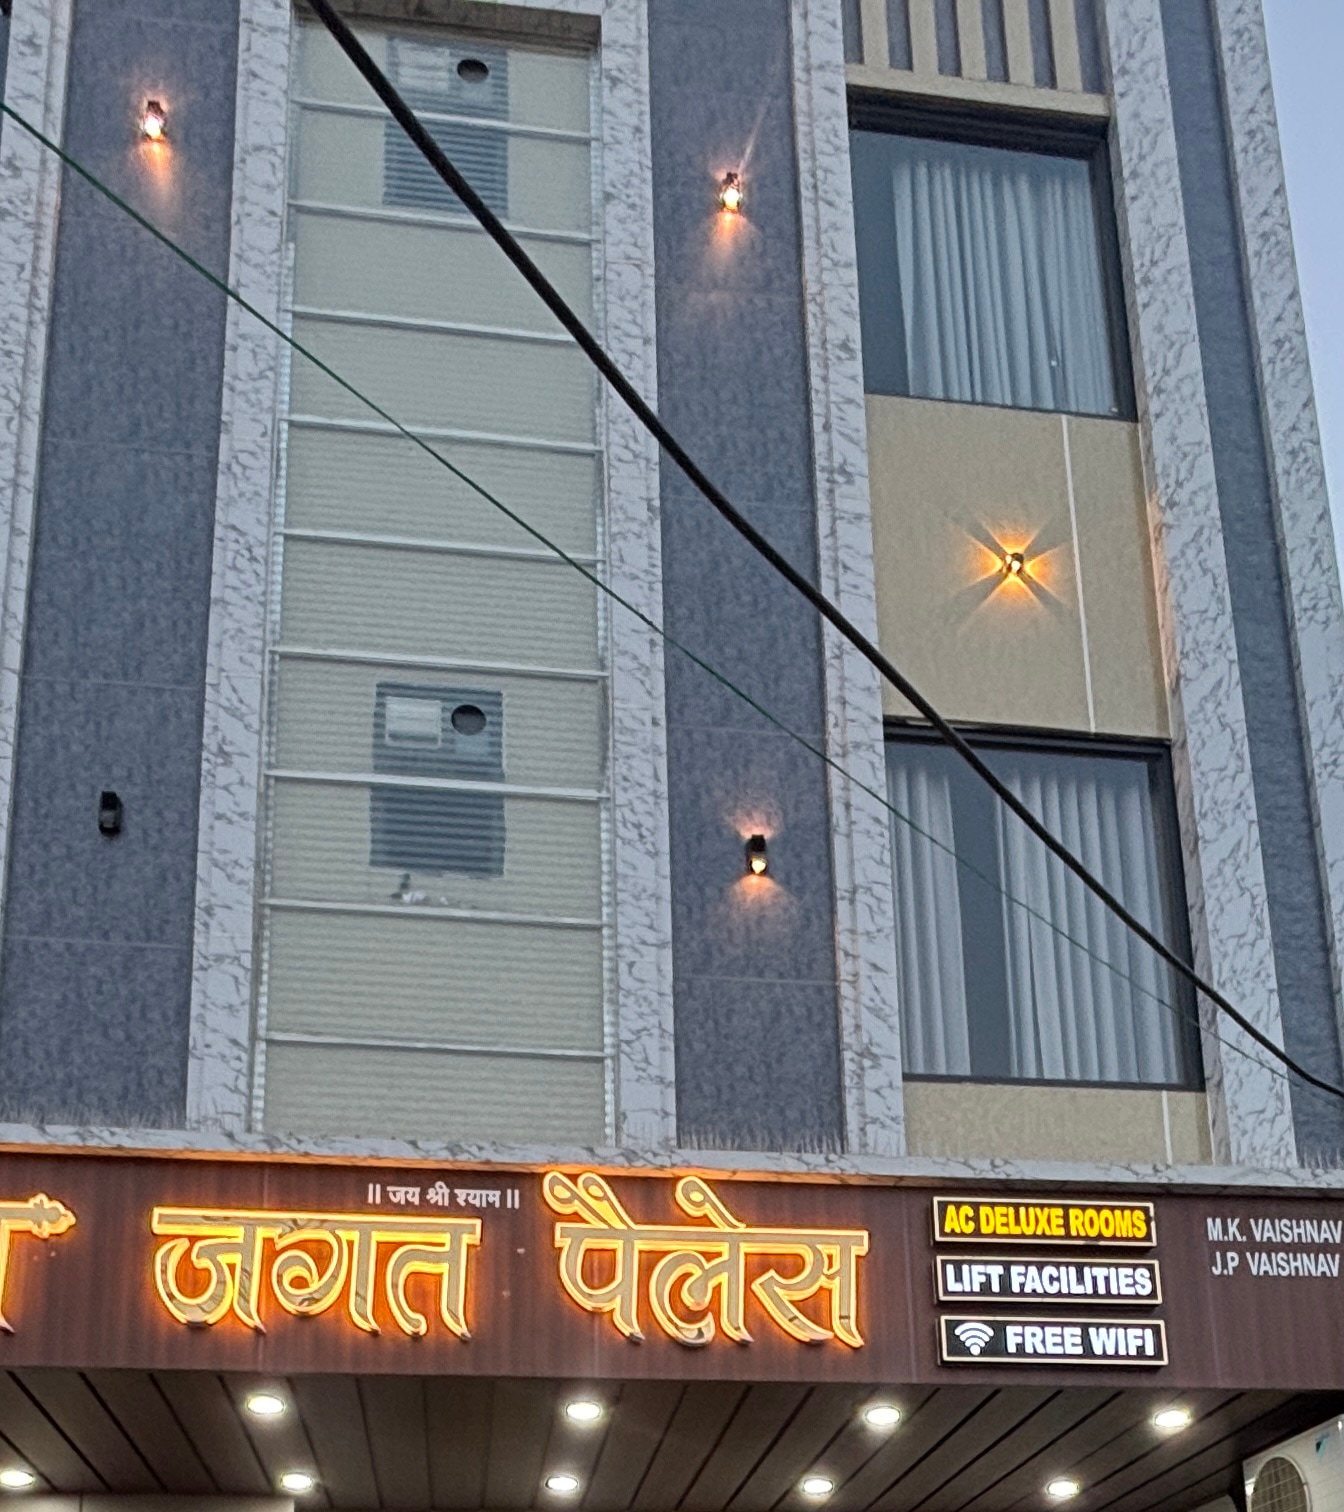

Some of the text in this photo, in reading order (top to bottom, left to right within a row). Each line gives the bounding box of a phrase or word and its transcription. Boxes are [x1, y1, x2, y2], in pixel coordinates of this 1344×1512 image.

[386, 1186, 421, 1206] जय
[425, 1180, 450, 1207] श्री
[454, 1188, 501, 1208] श्याम
[944, 1205, 1148, 1239] AC DELUXE ROOMS
[1206, 1217, 1247, 1243] M.K.
[1249, 1217, 1343, 1244] VAISHNAV
[151, 1169, 870, 1349] जगत पैलेस
[1211, 1250, 1341, 1278] J.P VAISHNAV
[945, 1263, 1153, 1297] LIFT FACILITIES
[1005, 1324, 1156, 1356] FREE WIFI
